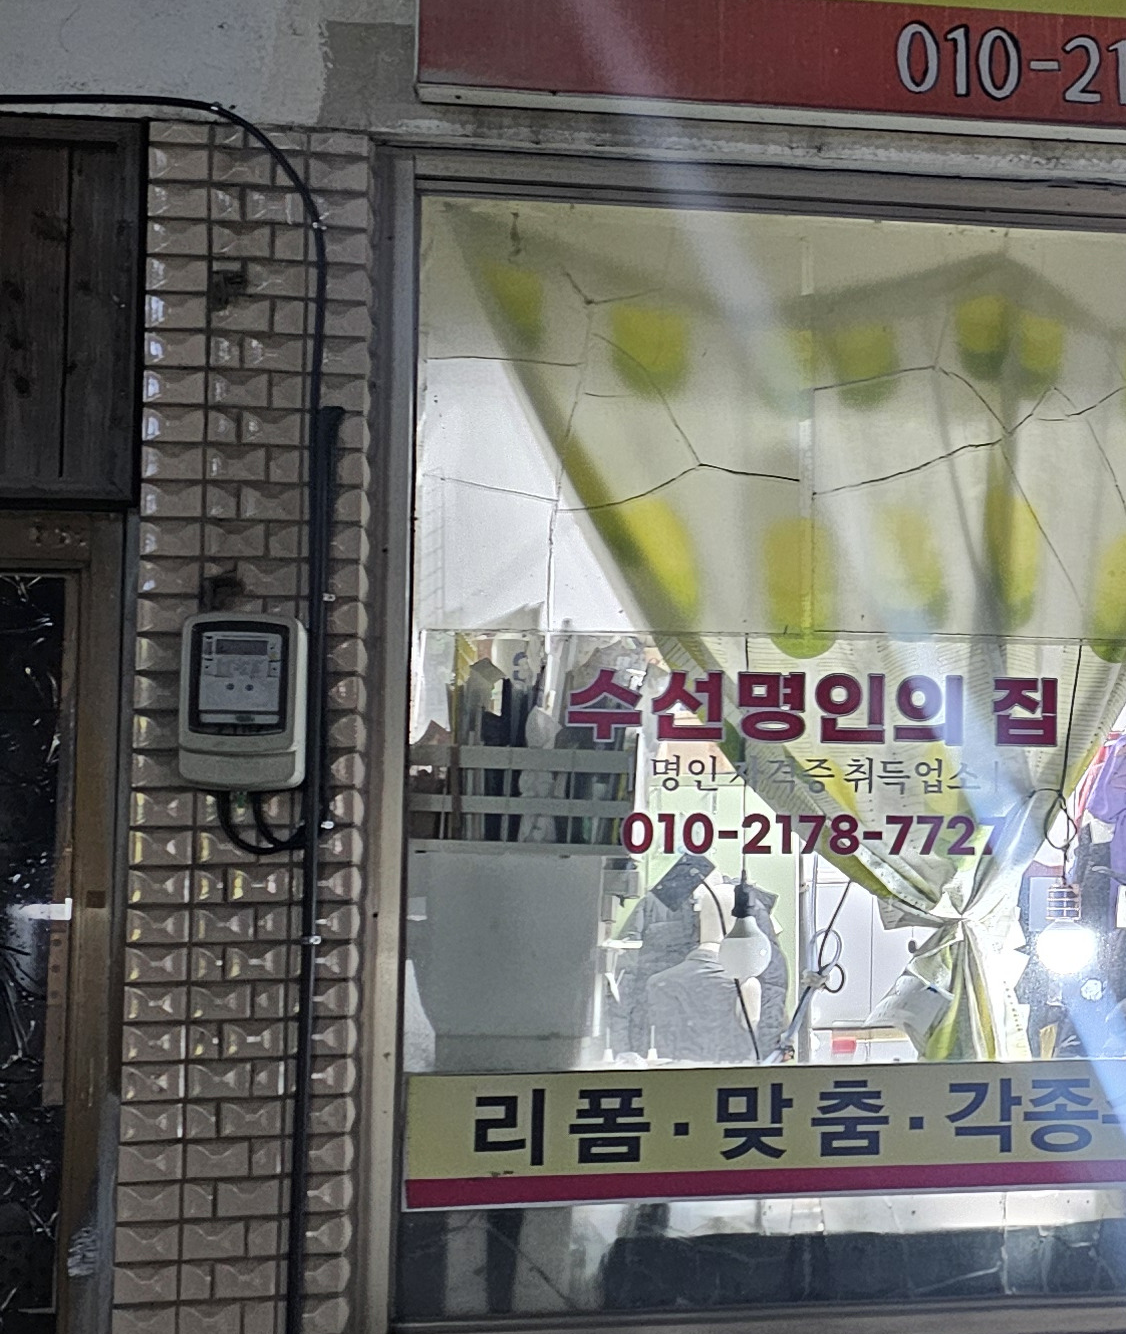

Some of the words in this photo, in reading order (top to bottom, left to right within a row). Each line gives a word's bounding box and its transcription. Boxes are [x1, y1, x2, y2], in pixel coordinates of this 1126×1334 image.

[566, 669, 964, 746] 수선명인의
[992, 677, 1059, 747] 집
[651, 754, 718, 791] 명인
[621, 812, 1006, 857] 010-2178-7727
